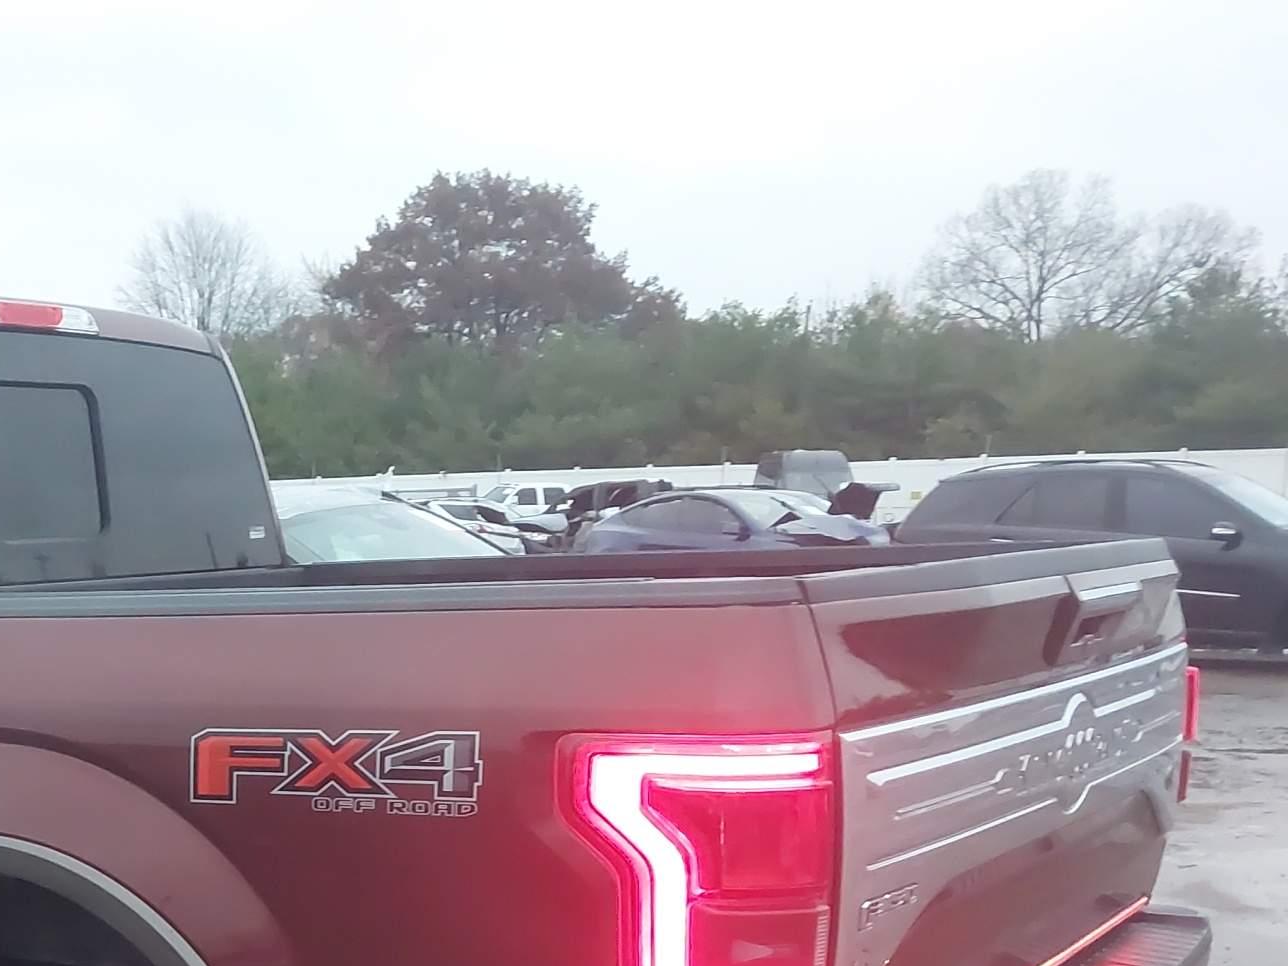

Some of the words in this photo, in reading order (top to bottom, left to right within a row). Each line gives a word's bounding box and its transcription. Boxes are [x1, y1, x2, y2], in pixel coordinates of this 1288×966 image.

[190, 728, 482, 803] FX4
[312, 797, 376, 812] OFF
[387, 800, 478, 817] ROAD
